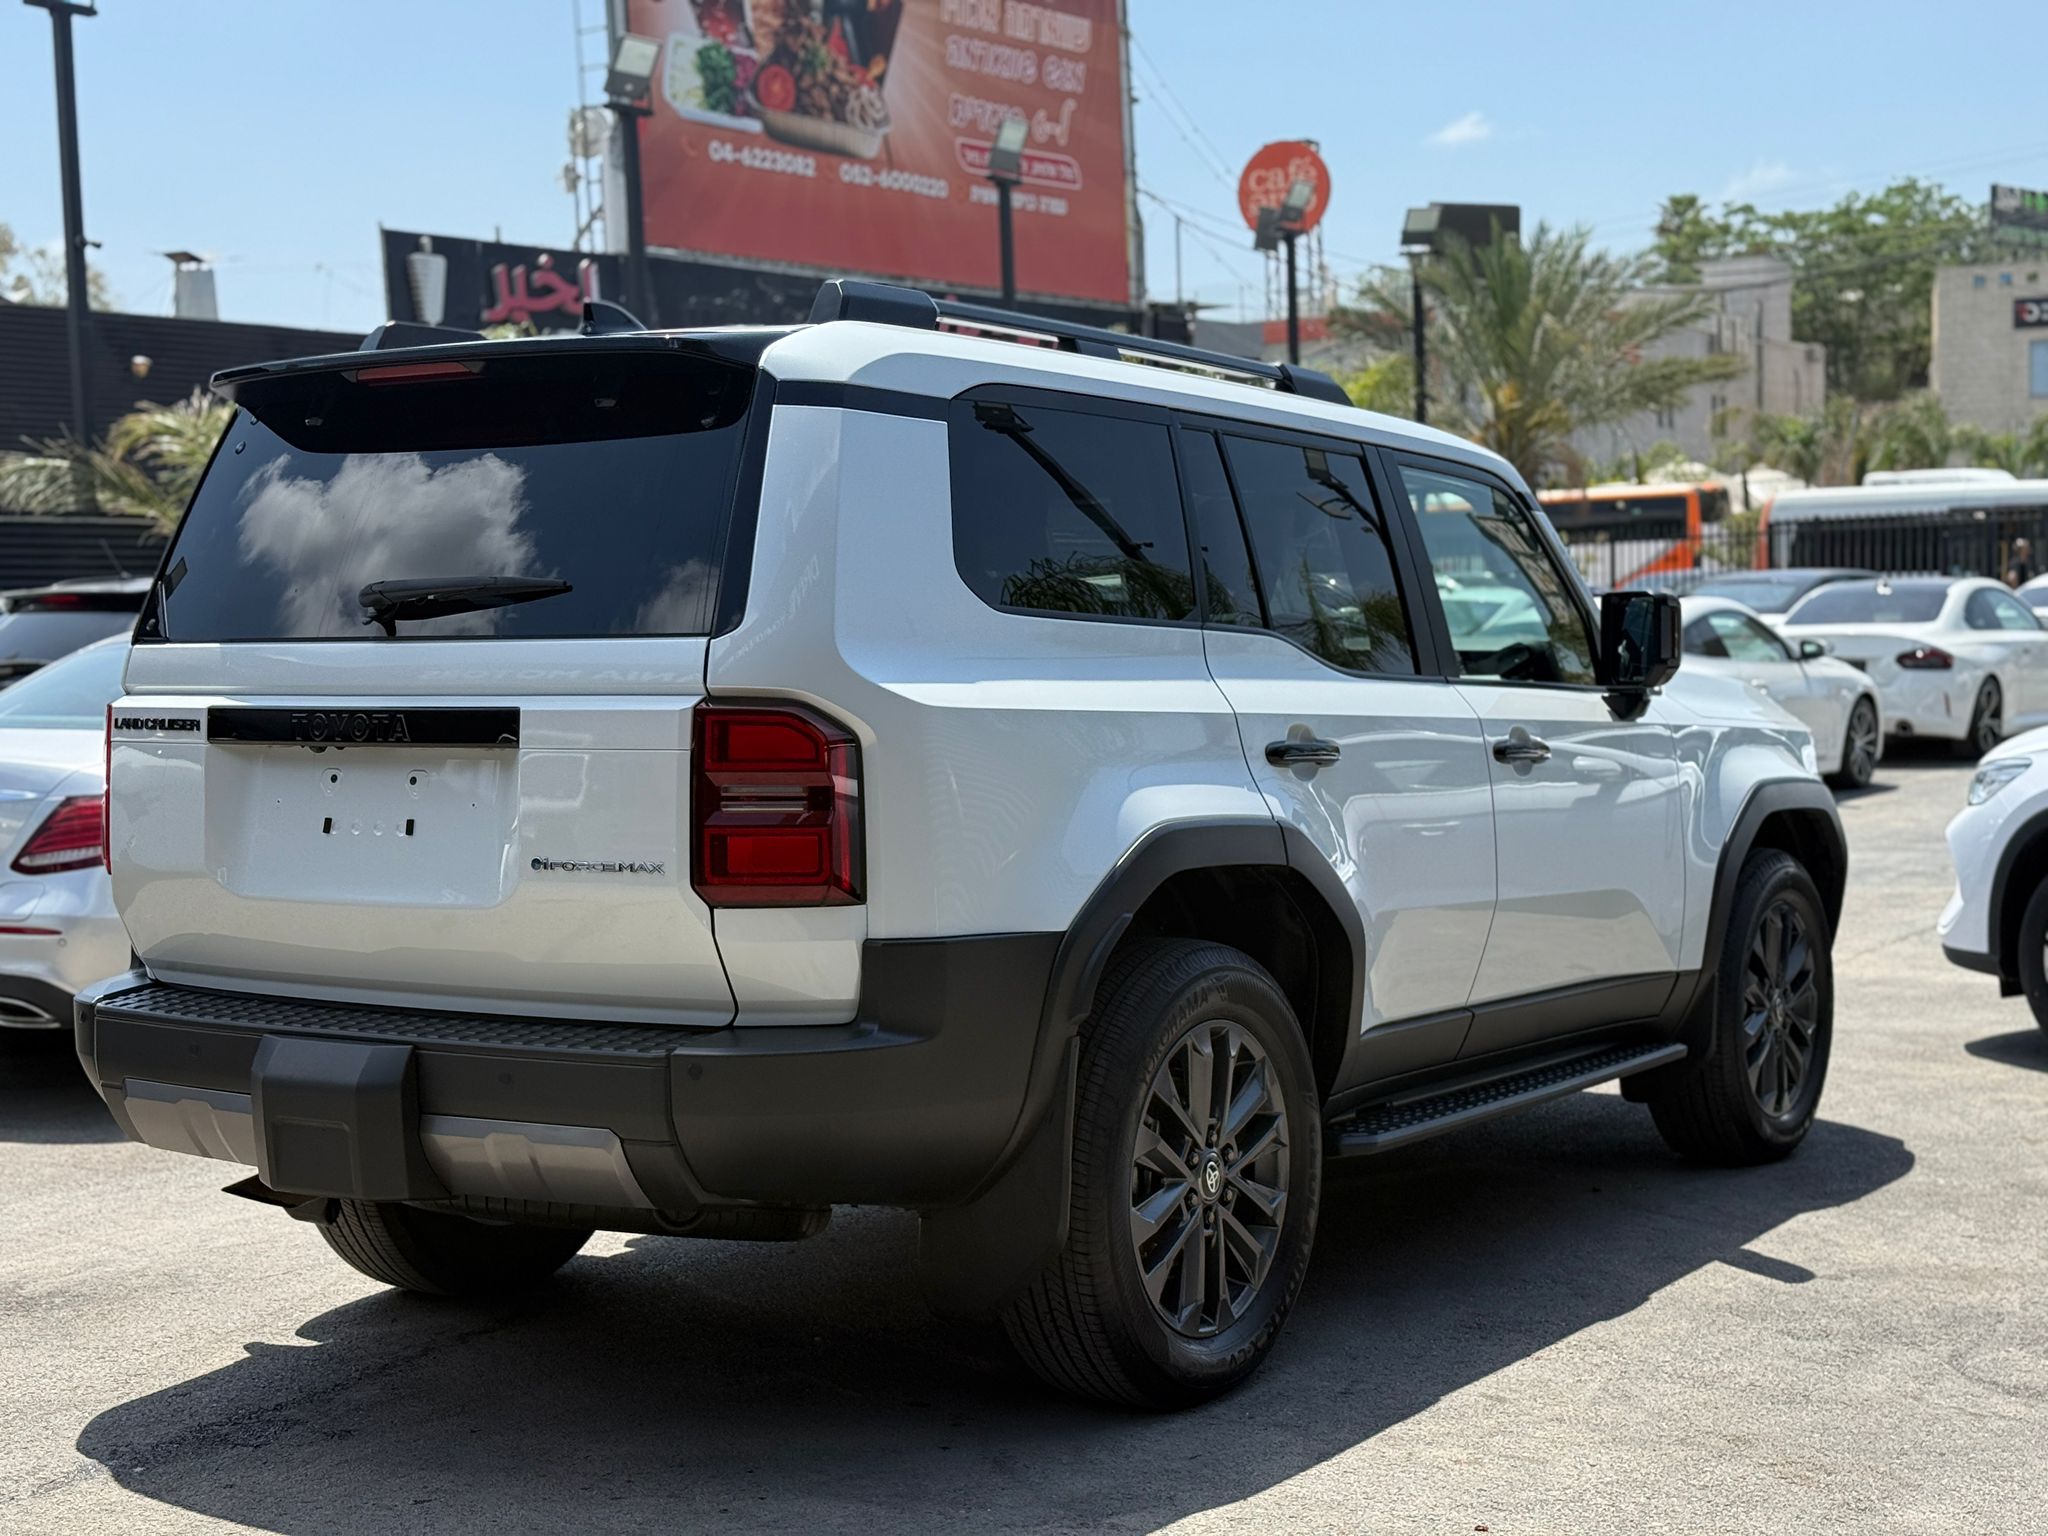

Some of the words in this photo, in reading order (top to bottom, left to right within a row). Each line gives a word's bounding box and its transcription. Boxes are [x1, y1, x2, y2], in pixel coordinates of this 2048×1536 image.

[114, 717, 144, 730] LAND
[145, 718, 201, 732] CRUISER
[290, 713, 411, 743] TOYOTA
